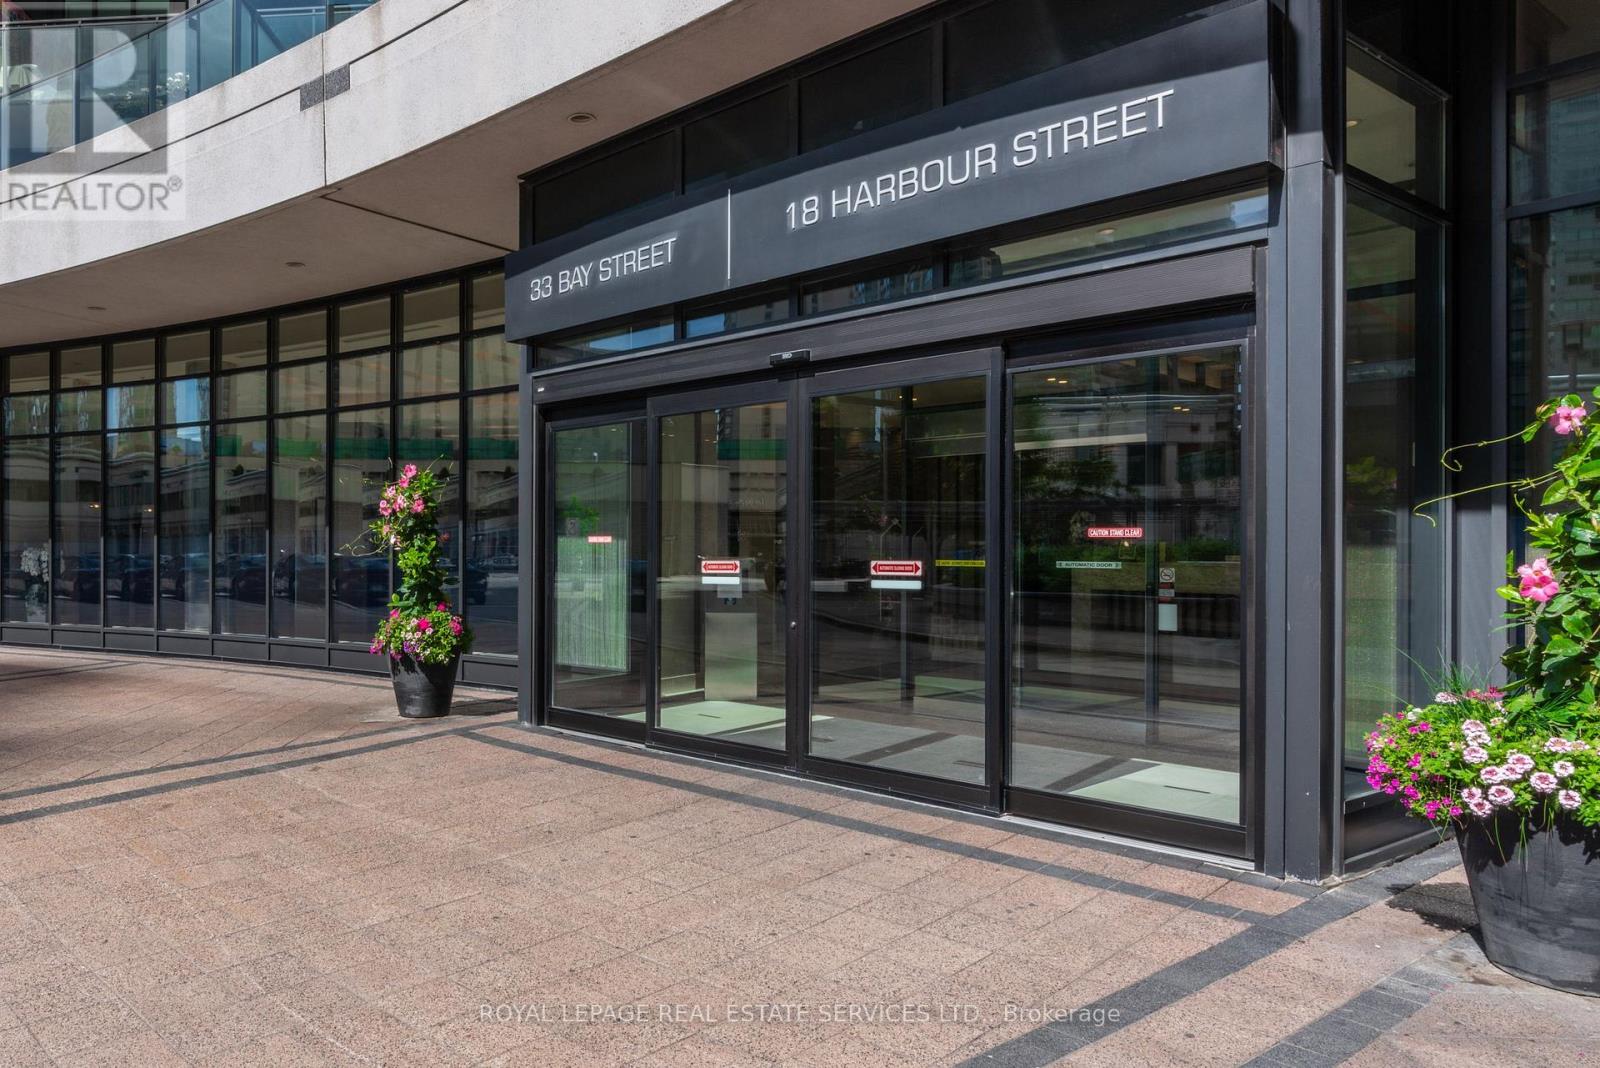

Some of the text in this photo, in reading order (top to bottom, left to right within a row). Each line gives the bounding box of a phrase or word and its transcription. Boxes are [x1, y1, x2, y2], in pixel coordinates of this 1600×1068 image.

[786, 88, 1175, 231] 18 HARBOUR STREET
[530, 237, 677, 301] 33 BAY STREET
[1090, 529, 1109, 537] CAUTION
[1124, 529, 1141, 537] CLEAR
